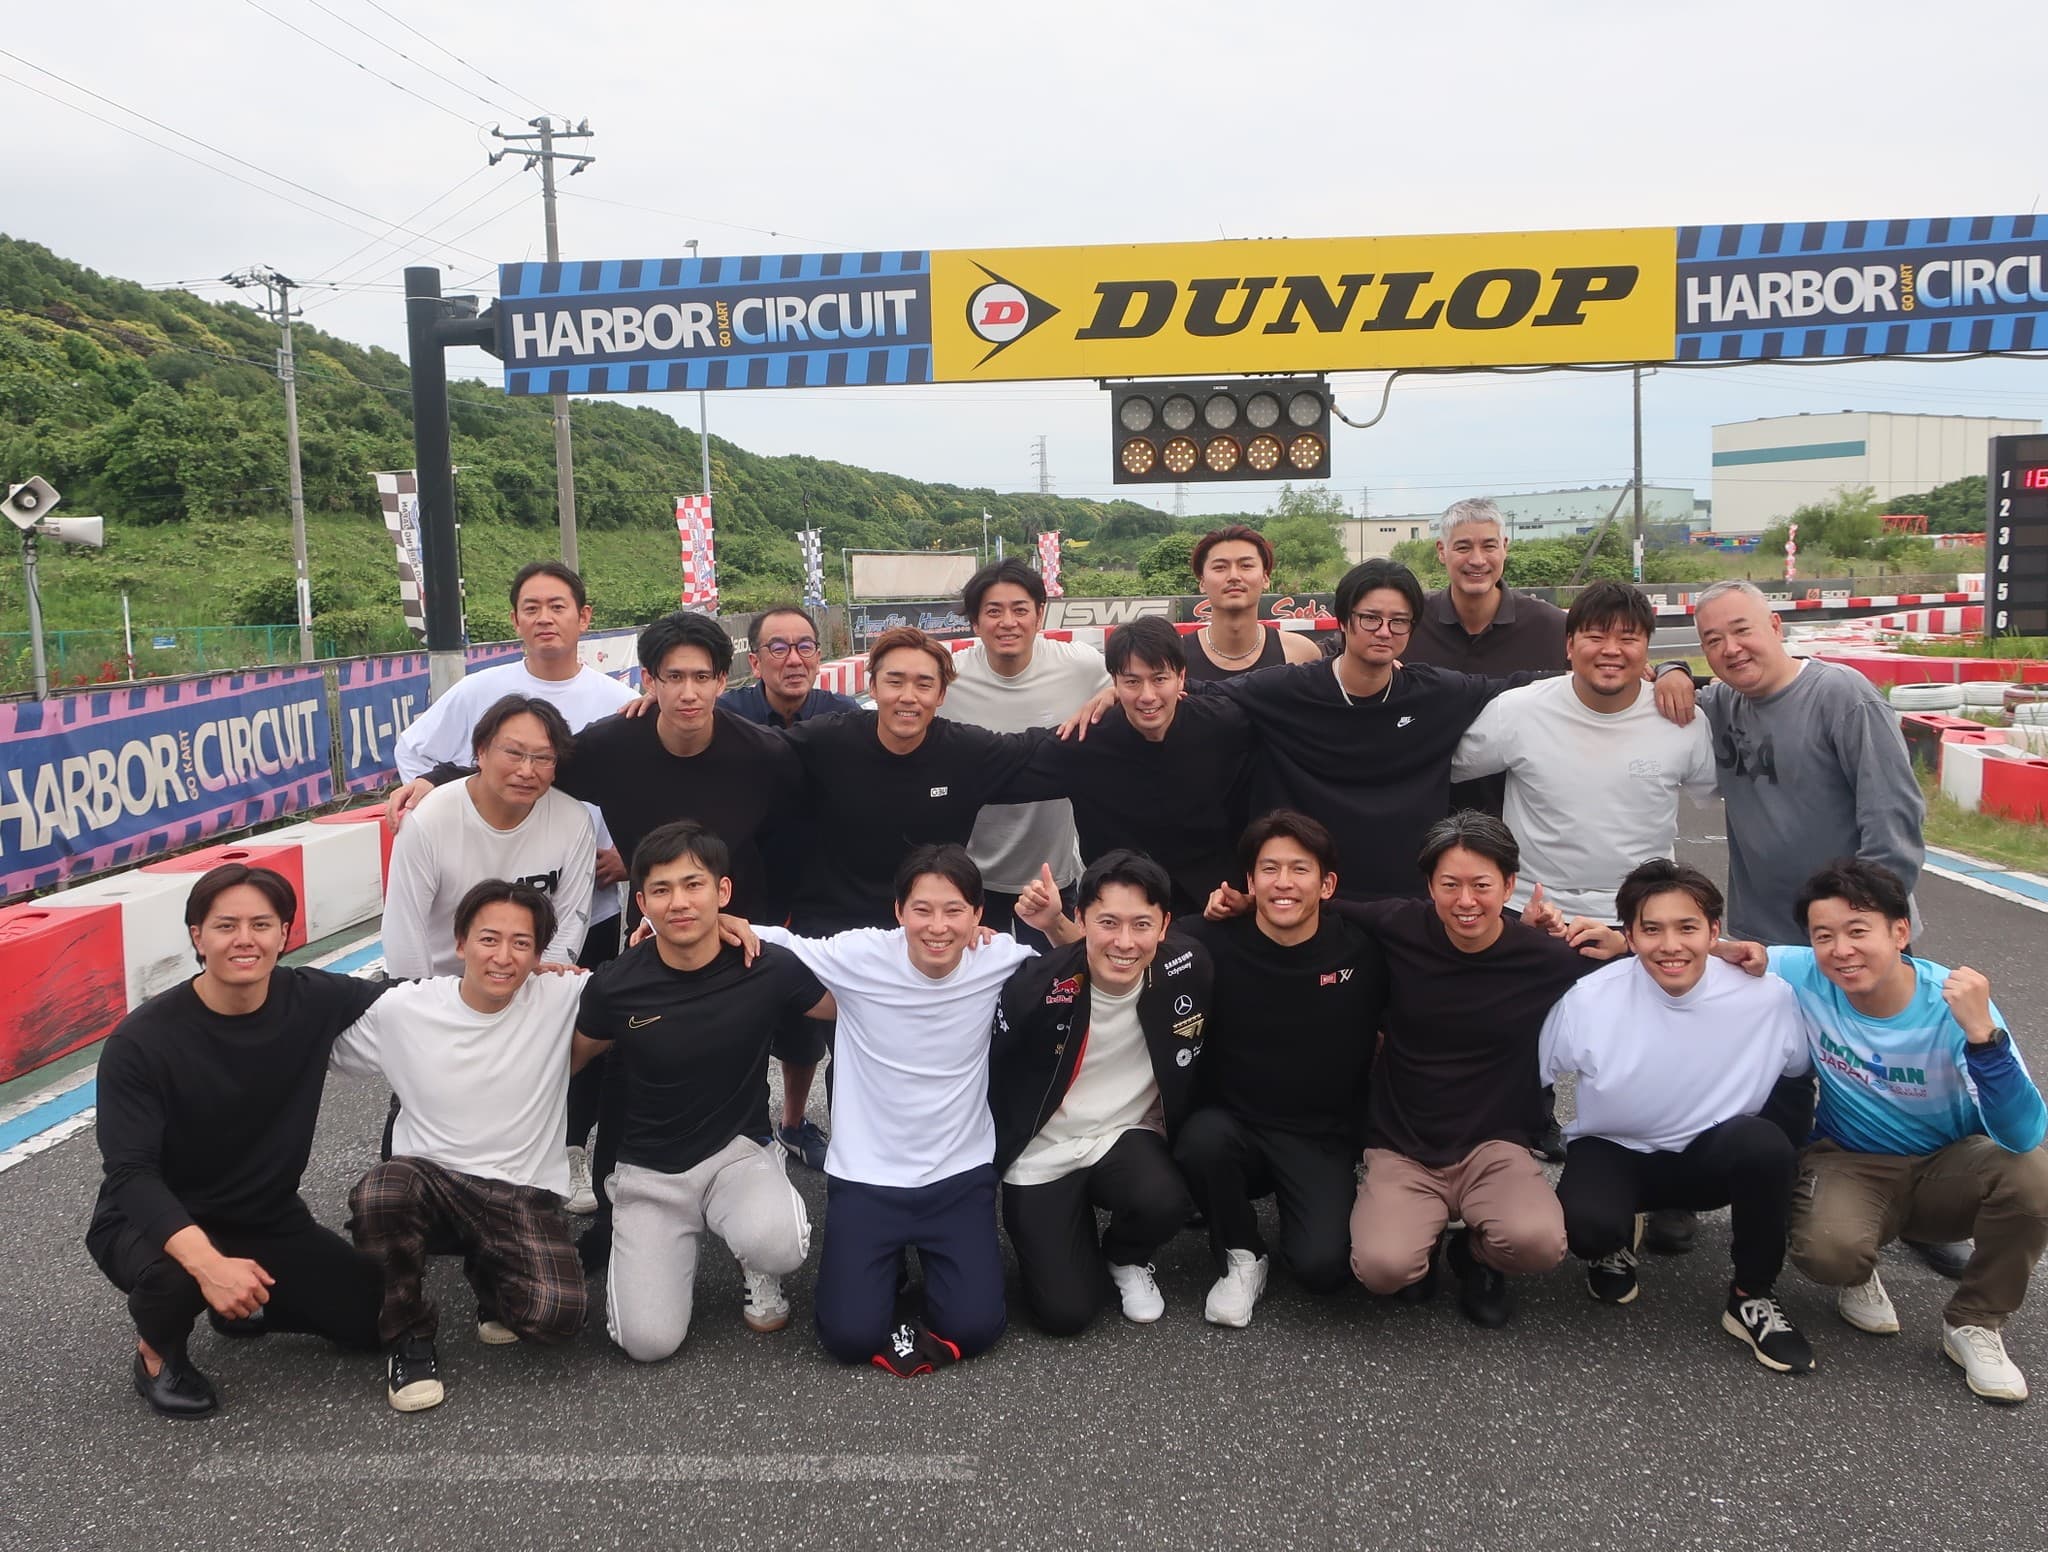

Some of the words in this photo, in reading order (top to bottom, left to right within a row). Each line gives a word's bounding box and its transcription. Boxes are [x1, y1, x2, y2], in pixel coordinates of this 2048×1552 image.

[1900, 264, 1914, 292] KART
[1074, 265, 1640, 340] DUNLOP
[1686, 265, 1898, 324] HARBOR
[1902, 292, 1914, 312] GO
[718, 300, 729, 329] KART
[732, 289, 917, 345] CIRCUIT
[979, 301, 1026, 325] D
[511, 302, 716, 360] HARBOR
[719, 330, 731, 348] GO
[2001, 470, 2011, 488] 1
[1999, 499, 2011, 517] 2
[1998, 527, 2010, 545] 3
[1998, 555, 2010, 573] 4
[1997, 583, 2009, 601] 5
[1996, 611, 2009, 629] 6
[179, 730, 191, 774] KART
[194, 699, 319, 793] CIRCUIT
[0, 734, 189, 858] HARBOR
[188, 779, 200, 801] GO
